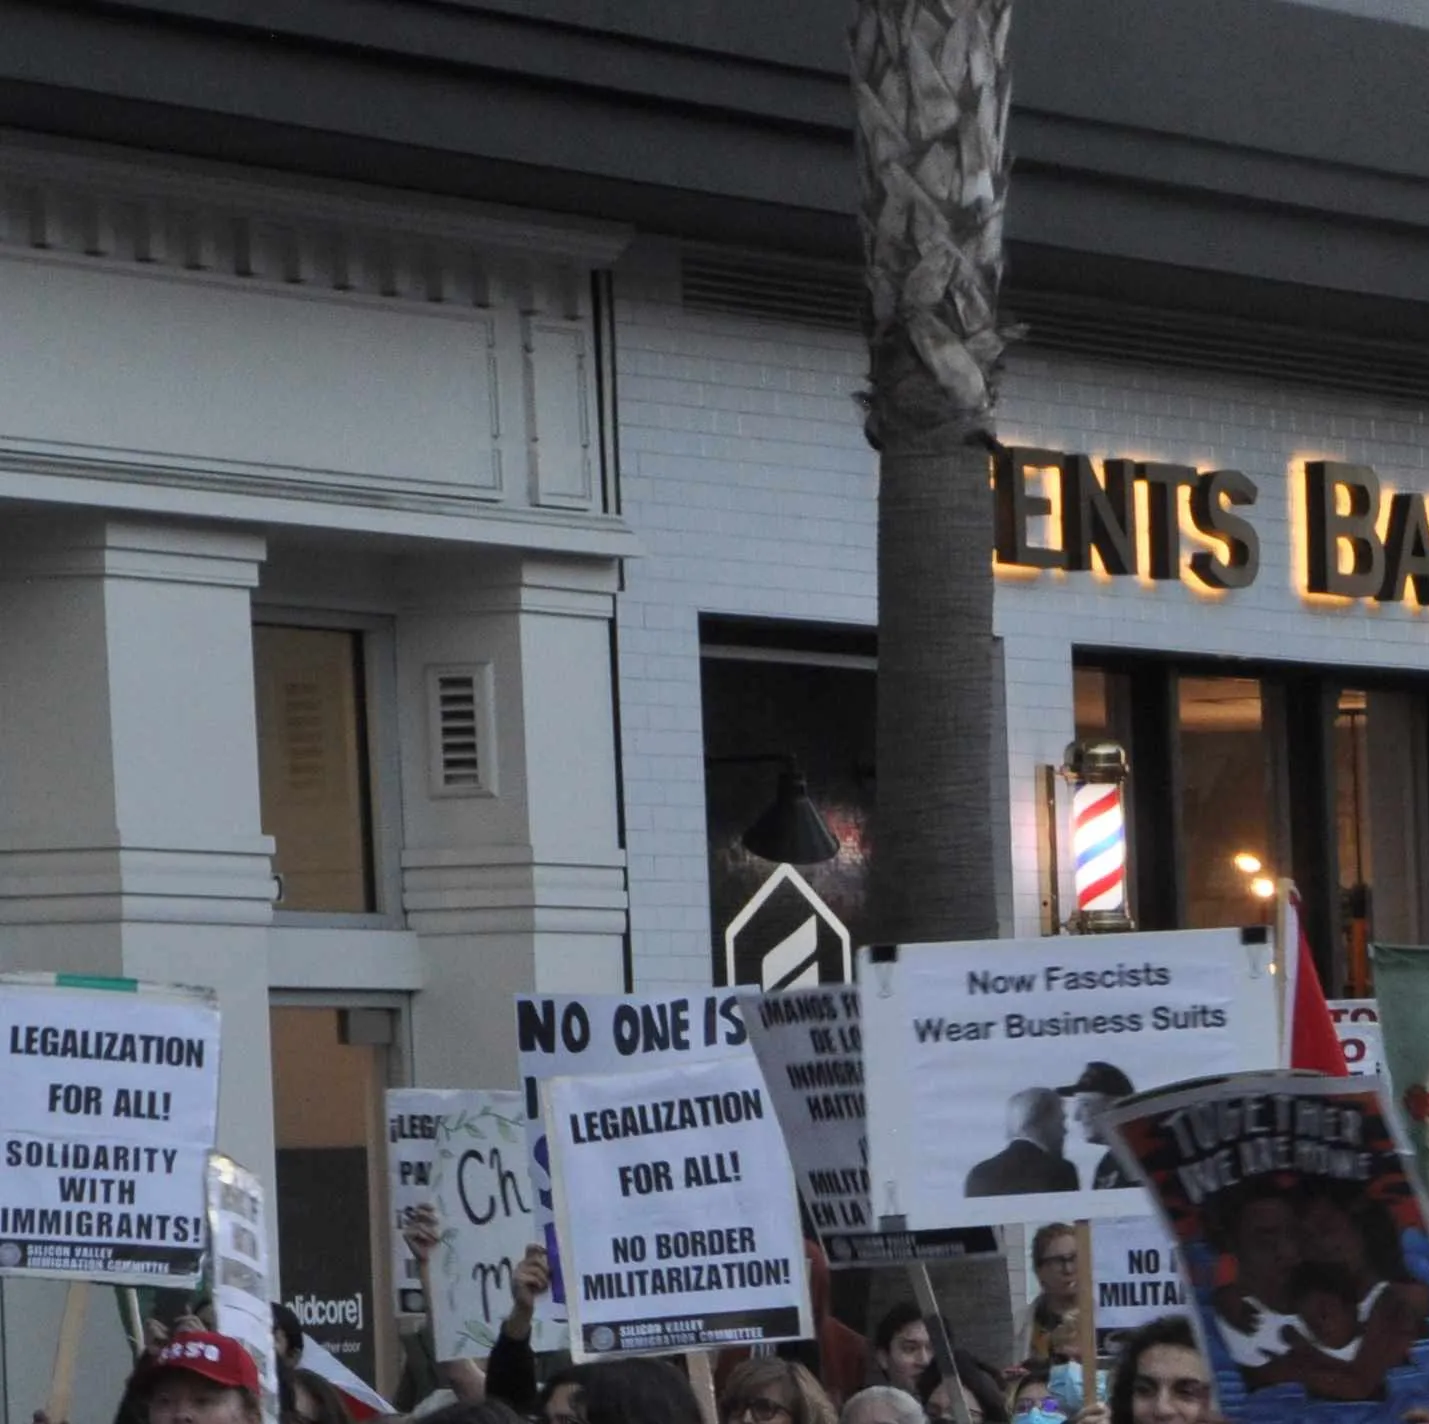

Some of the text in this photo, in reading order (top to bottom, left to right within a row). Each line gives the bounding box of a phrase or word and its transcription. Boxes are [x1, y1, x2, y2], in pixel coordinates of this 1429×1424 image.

[995, 444, 1260, 592] ENTS
[967, 963, 1171, 995] Now Fascists
[517, 996, 747, 1056] NO ONE IS
[913, 1004, 1228, 1044] Wear Business Suits
[10, 1025, 204, 1068] LEGALIZATION
[48, 1084, 172, 1121] FOR ALL!
[570, 1089, 763, 1144] LEGALIZATION
[6, 1140, 178, 1174] SOLIDARITY
[619, 1151, 741, 1197] FOR ALL!
[59, 1176, 136, 1205] WITH
[1, 1207, 201, 1243] IMMIGRANTS!
[74, 1246, 114, 1259] VALLEY
[612, 1227, 756, 1264] NO BORDER
[1128, 1249, 1160, 1275] NO
[583, 1258, 791, 1301] MILITARIZATION!
[699, 1326, 763, 1341] COMMITTEE
